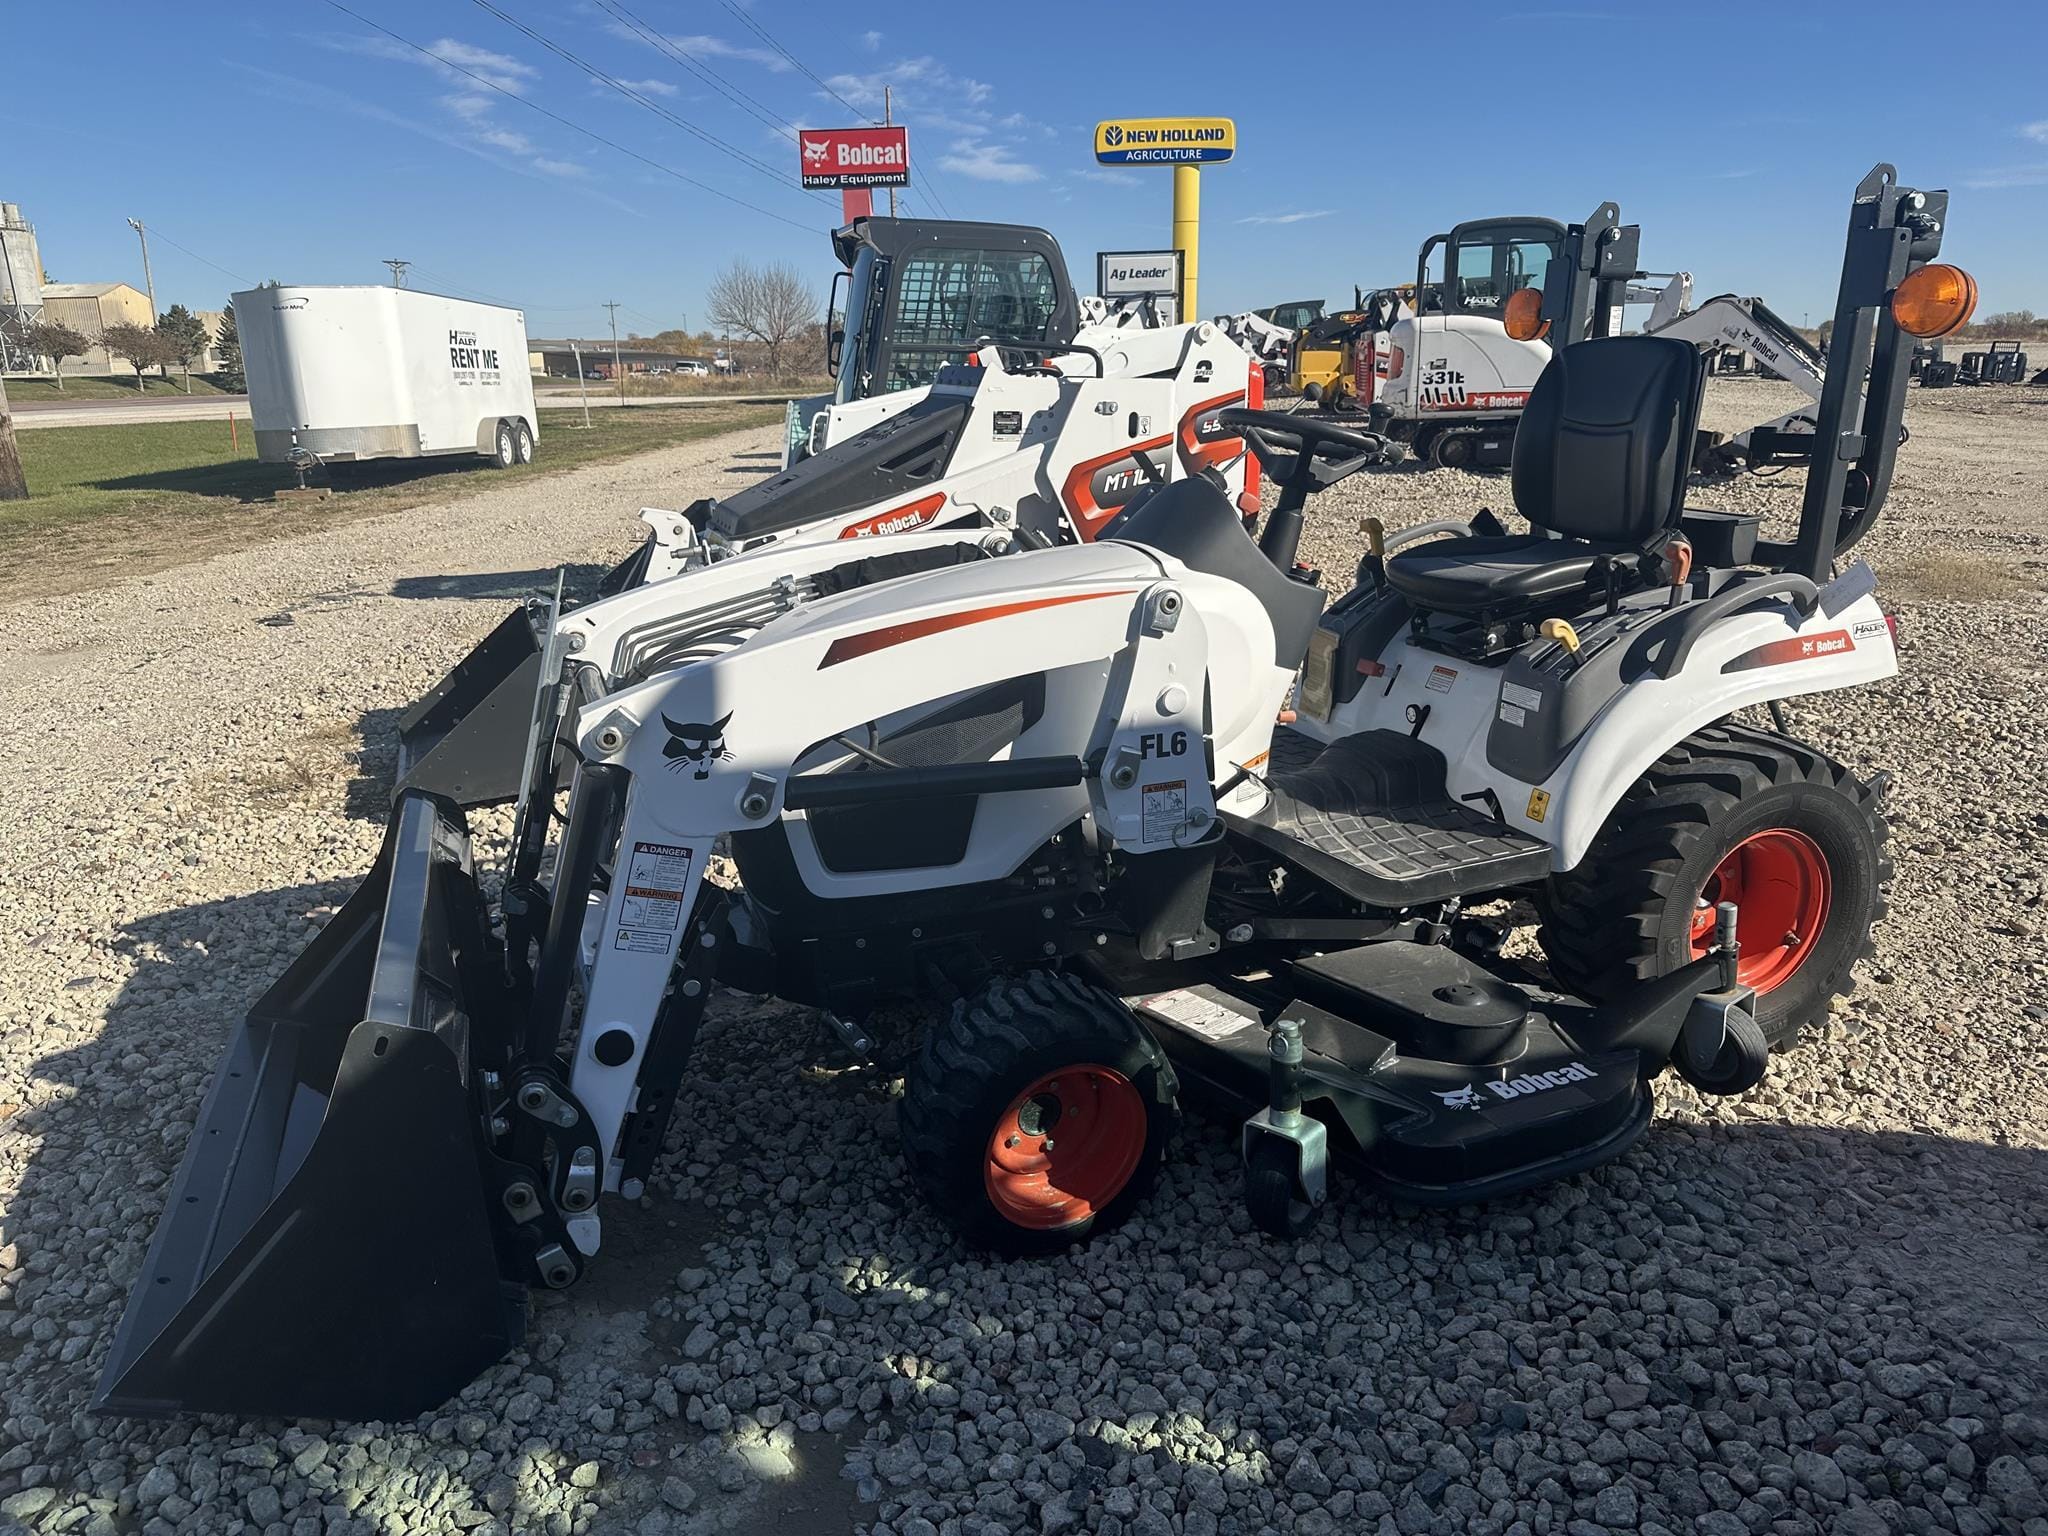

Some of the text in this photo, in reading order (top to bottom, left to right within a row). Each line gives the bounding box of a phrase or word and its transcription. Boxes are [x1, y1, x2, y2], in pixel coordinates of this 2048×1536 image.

[1126, 128, 1225, 143] NEW HOLLAND
[837, 142, 904, 166] Bobcat
[1126, 149, 1202, 161] AGRICULTURE
[803, 173, 906, 186] Haley Equipment
[1110, 267, 1169, 281] Ag Leader
[449, 329, 477, 346] HALEY
[1751, 336, 1779, 363] Bobcat
[450, 347, 499, 369] RENT ME
[1193, 359, 1213, 383] 2
[1489, 395, 1524, 407] Bobcat
[877, 510, 921, 535] Bobcat
[1855, 624, 1886, 635] HALEY
[1816, 637, 1846, 653] Bobcat
[1140, 731, 1187, 760] FL6
[649, 846, 688, 857] DANGER
[639, 891, 678, 900] WARNING
[1485, 1062, 1599, 1100] Bobcat
